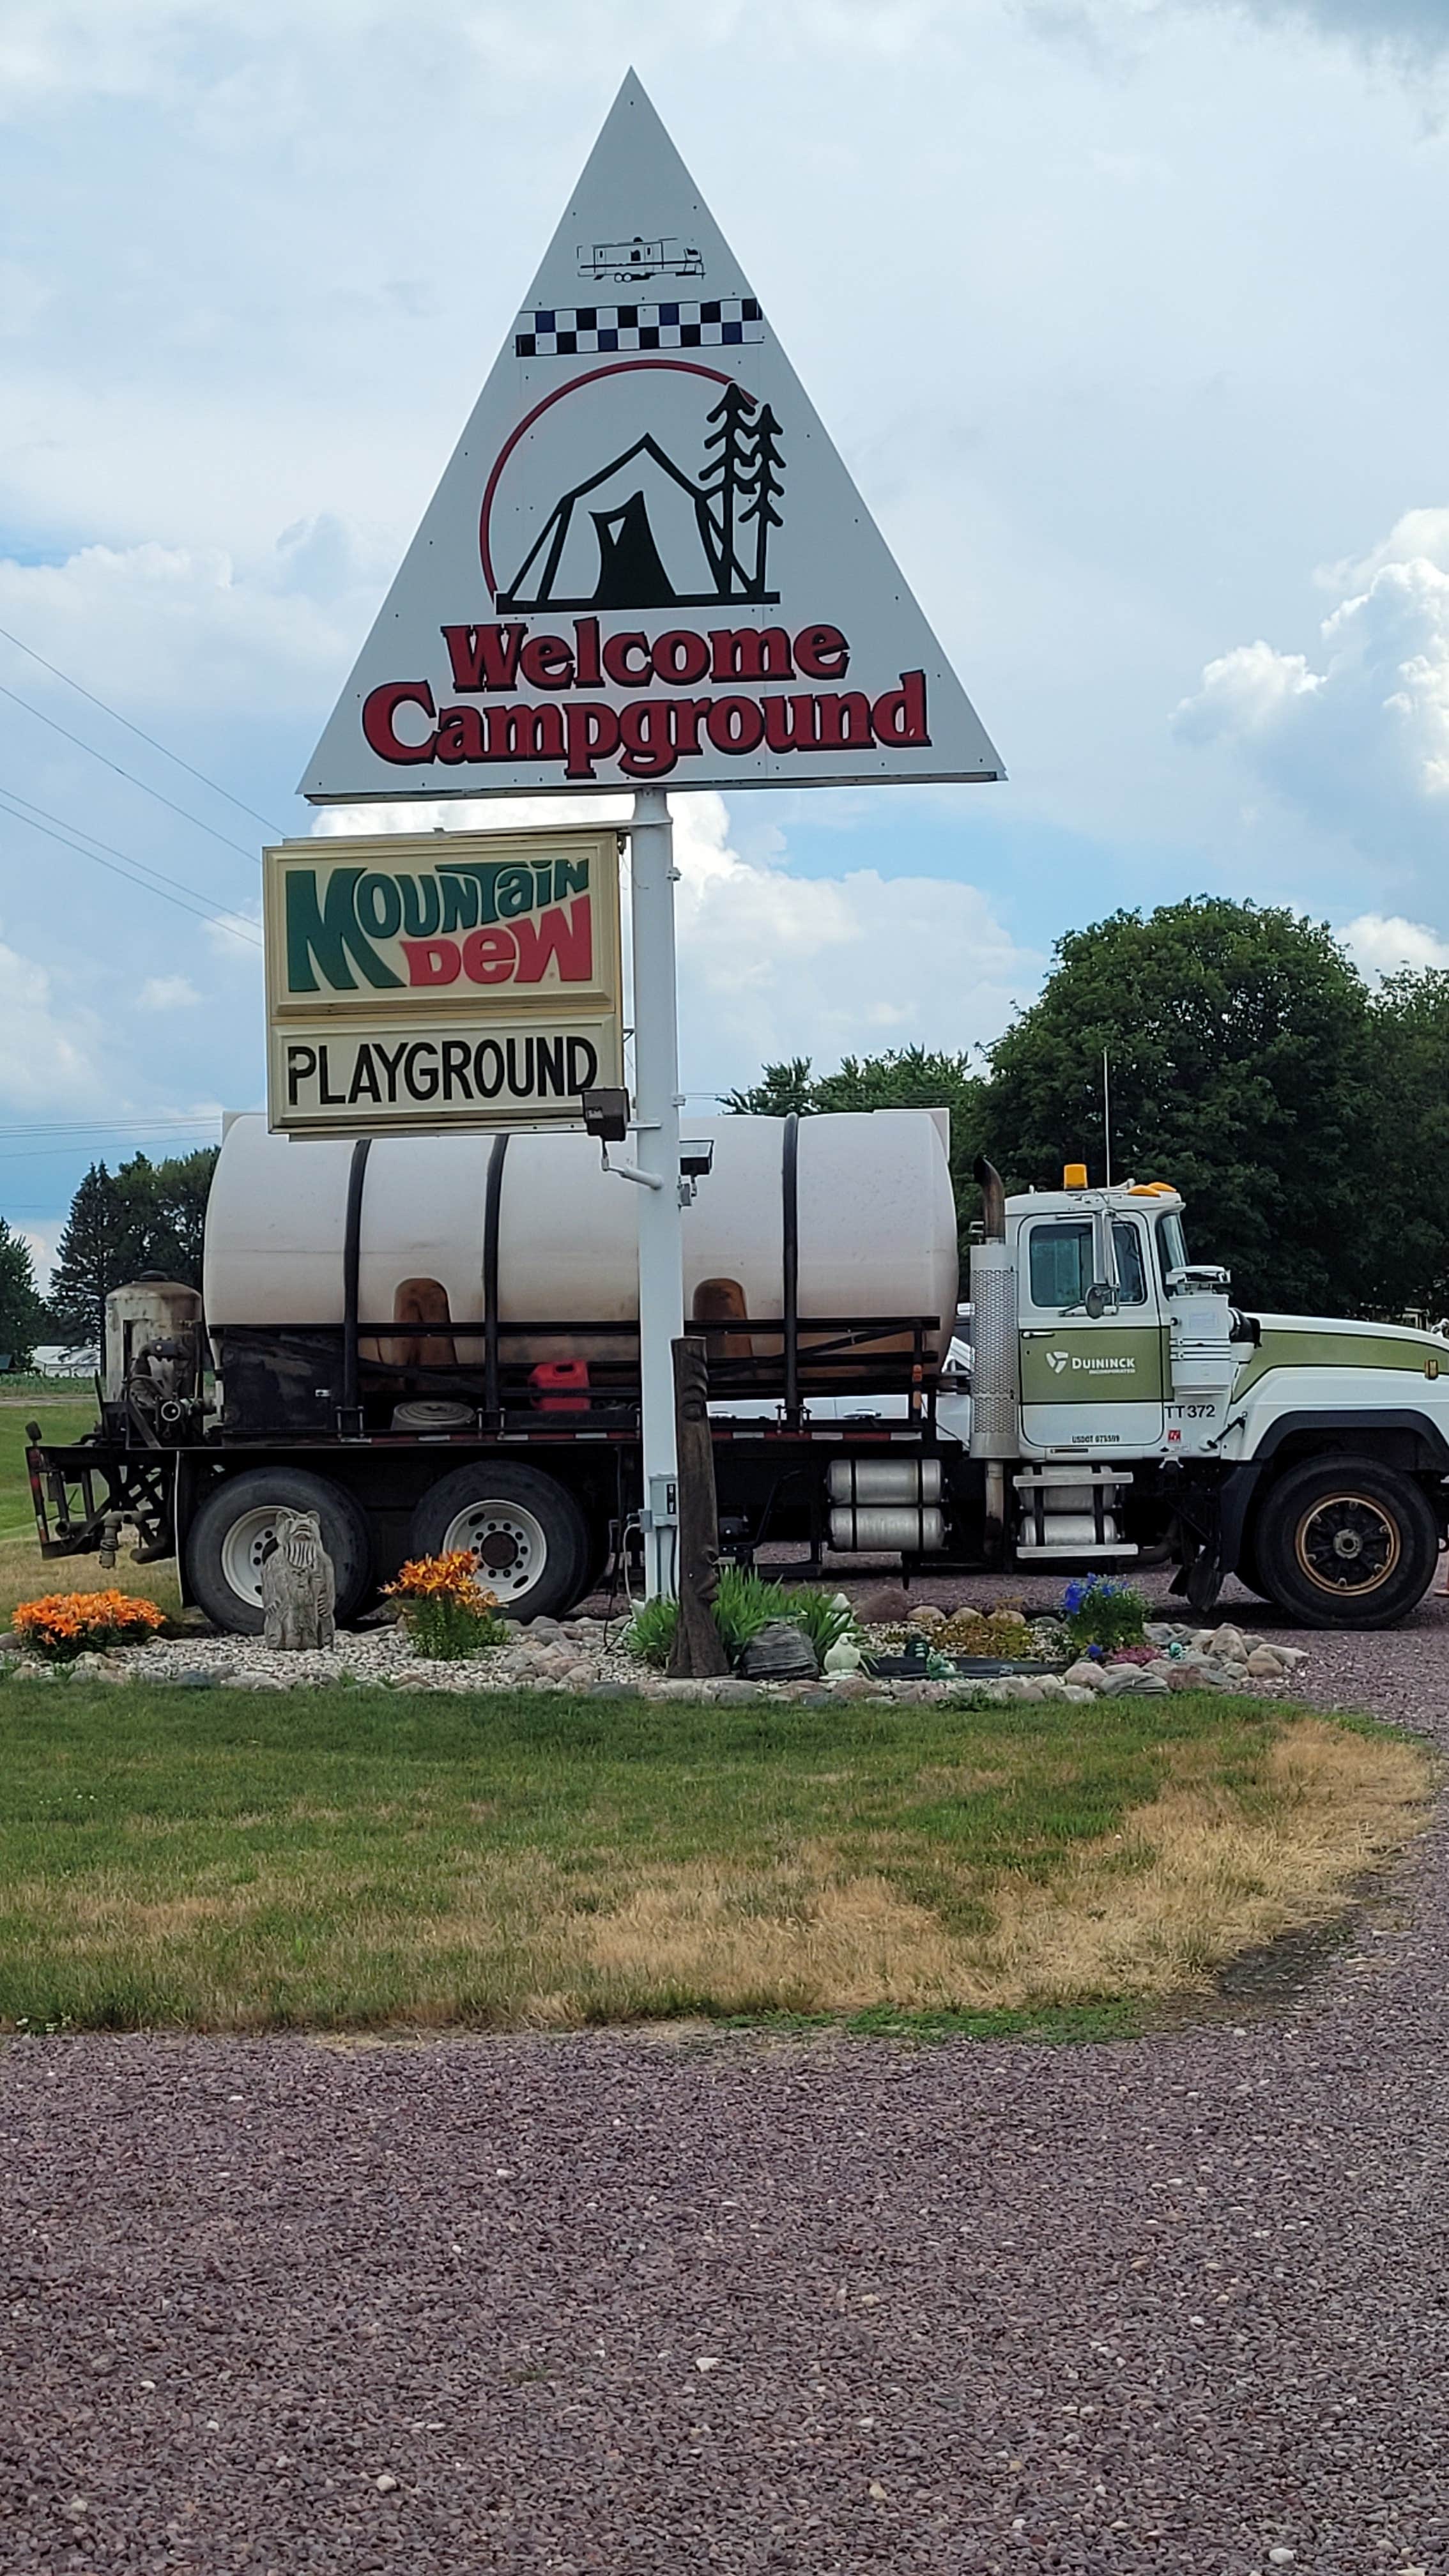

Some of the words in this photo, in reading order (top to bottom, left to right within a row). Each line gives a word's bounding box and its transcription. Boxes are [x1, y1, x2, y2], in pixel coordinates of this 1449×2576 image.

[440, 617, 850, 694] Welcome
[362, 670, 931, 779] Campground
[287, 1037, 598, 1106] PLAYGROUND
[1072, 1357, 1135, 1369] DUININCK
